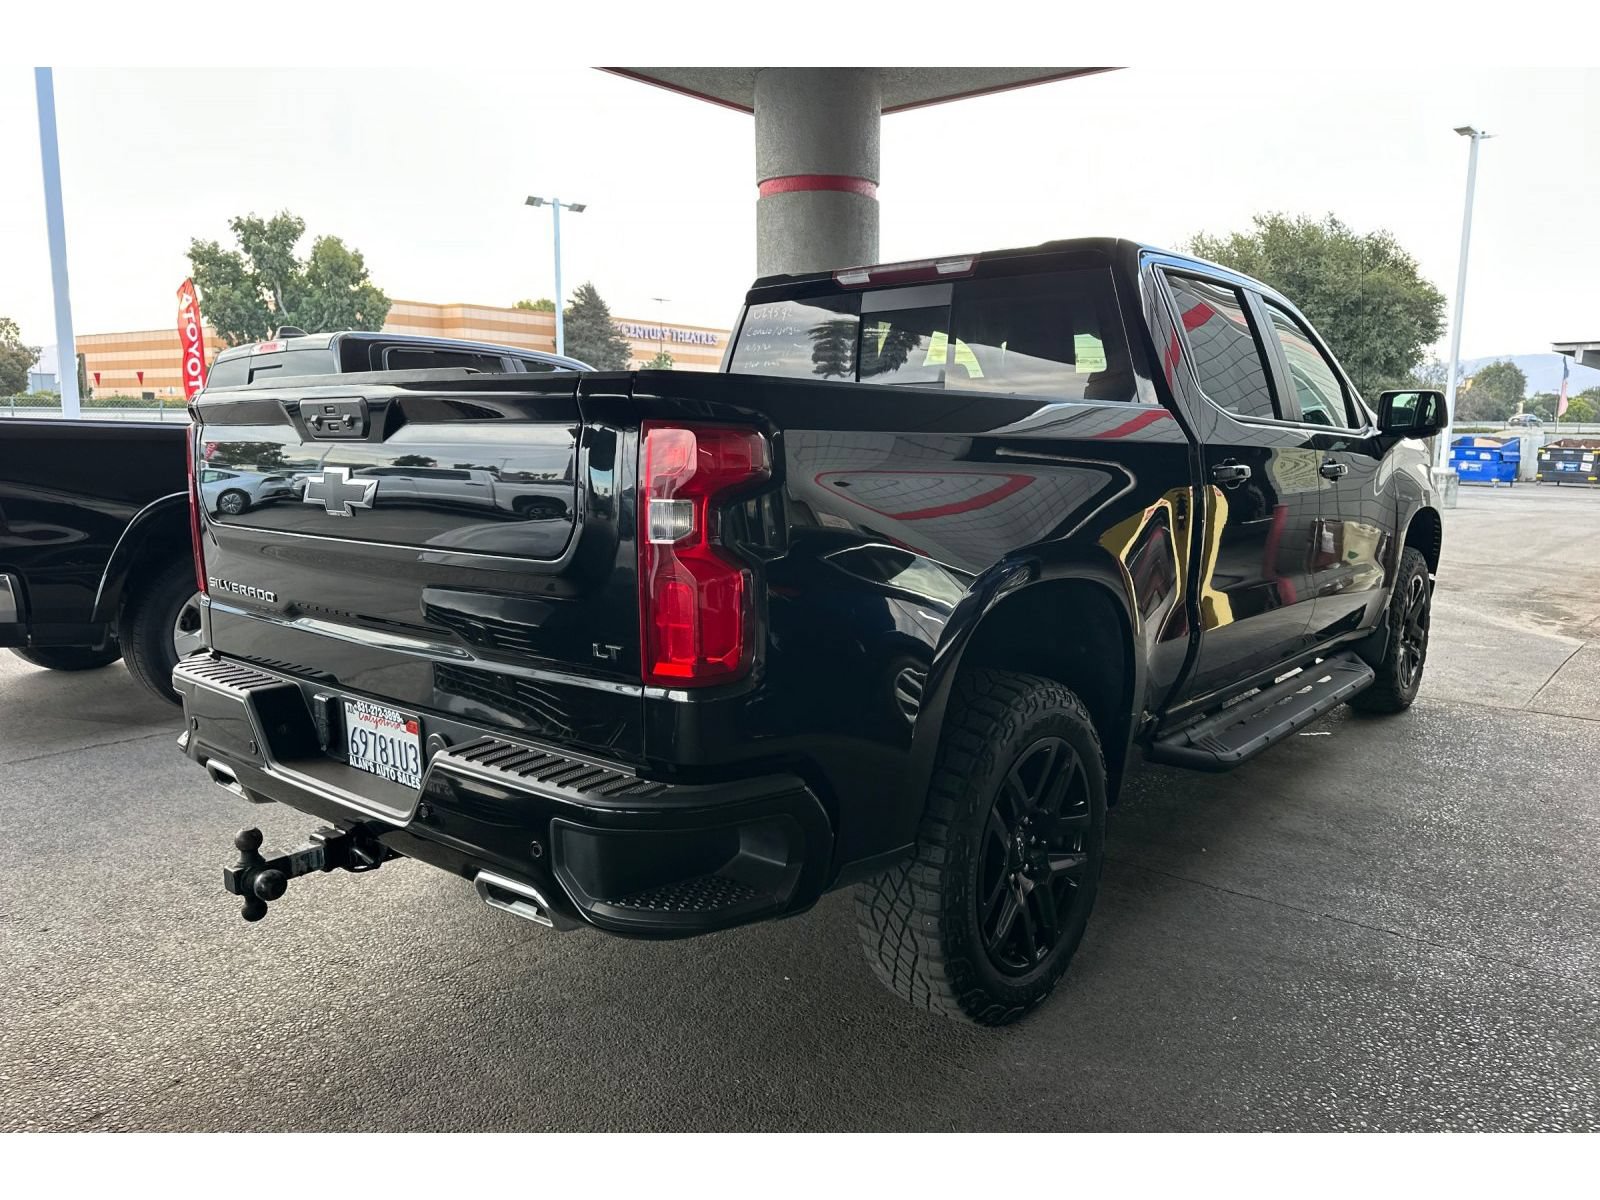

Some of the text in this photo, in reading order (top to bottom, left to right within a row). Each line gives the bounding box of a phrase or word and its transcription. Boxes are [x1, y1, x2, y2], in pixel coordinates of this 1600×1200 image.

[209, 576, 275, 603] SILVERADO
[592, 642, 624, 660] LT
[351, 727, 419, 775] 69781U3
[349, 754, 421, 790] ALAN'S AUTO SALES
